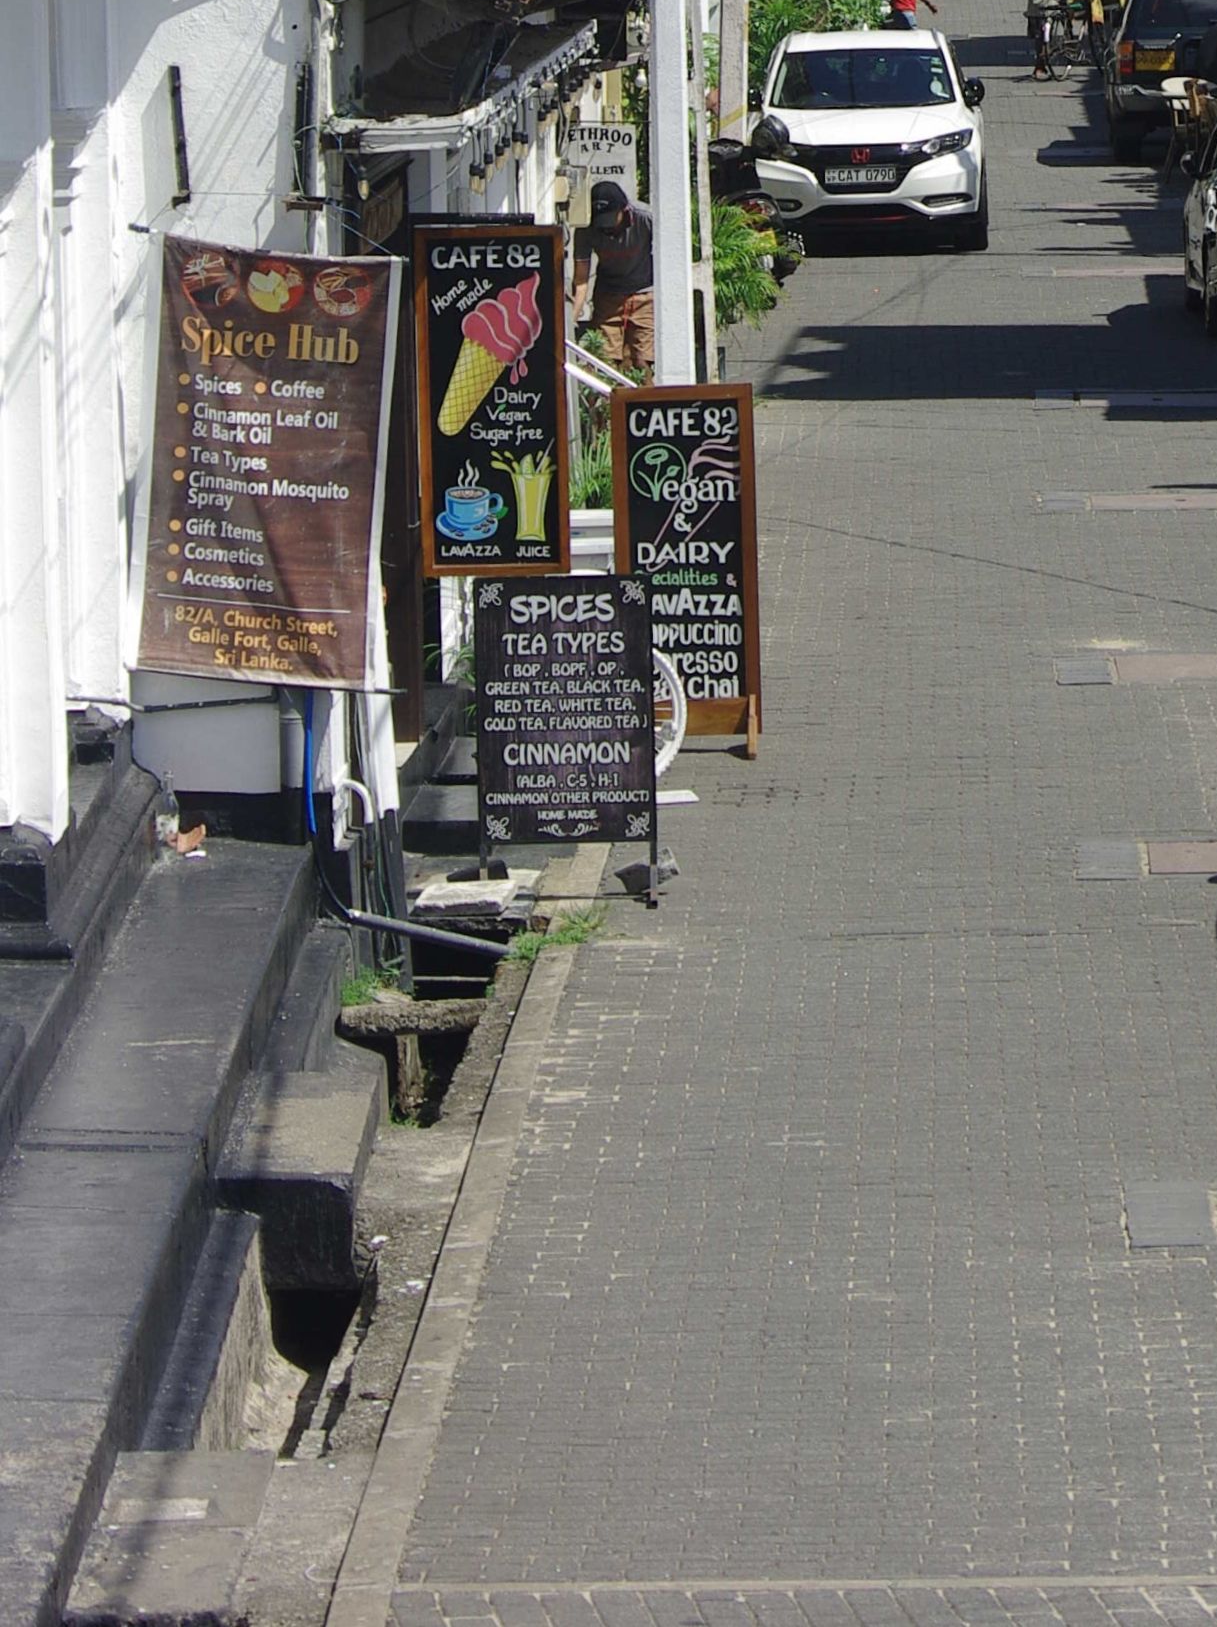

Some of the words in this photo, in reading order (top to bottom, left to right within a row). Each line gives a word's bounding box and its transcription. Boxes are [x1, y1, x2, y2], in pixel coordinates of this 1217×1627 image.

[581, 141, 615, 153] ART
[590, 165, 626, 175] LLERY
[838, 169, 861, 182] CAT
[866, 168, 896, 181] 0790
[431, 239, 504, 269] CAFÉ
[506, 243, 541, 269] 82
[430, 279, 468, 316] Home
[456, 277, 494, 313] made
[181, 316, 277, 366] Spice
[286, 323, 360, 364] Hub
[195, 373, 242, 396] Spices
[271, 379, 325, 399] Coffee
[494, 386, 542, 410] Dairy
[193, 402, 271, 426] Cinnamon
[276, 409, 311, 428] Leaf
[315, 411, 338, 430] Oil
[486, 404, 532, 425] Vegan
[628, 401, 701, 438] CAFÉ
[703, 407, 739, 436] 82
[192, 420, 207, 438] &
[212, 423, 245, 444] Bark
[250, 426, 272, 445] Oil
[470, 422, 513, 447] Sugar
[515, 424, 544, 446] free
[190, 446, 219, 465] Tea
[223, 450, 268, 474] Types
[189, 470, 268, 496] Cinnamon
[272, 479, 349, 503] Mosquito
[648, 476, 737, 514] Vegan
[188, 488, 234, 511] Spray
[185, 517, 217, 537] Gift
[220, 521, 264, 543] Items
[673, 512, 692, 532] &
[184, 541, 264, 566] Cosmetics
[441, 542, 501, 557] LAVAZZA
[516, 545, 551, 558] JUICE
[637, 541, 735, 565] DAIRY
[182, 568, 274, 593] Accessories
[642, 568, 718, 586] ecialities
[726, 573, 738, 587] &
[510, 593, 615, 623] SPICES
[652, 587, 742, 616] AVAZZA
[175, 604, 217, 627] 82/A,
[223, 610, 281, 631] Church
[286, 616, 338, 638] Street,
[652, 619, 742, 648] ppuccino
[189, 626, 230, 646] Galle
[234, 632, 272, 651] Fort,
[277, 634, 322, 656] Galle,
[502, 633, 547, 655] TEA
[552, 631, 625, 654] TYPES
[214, 648, 236, 666] Sri
[240, 651, 294, 670] Lanka.
[658, 650, 738, 674] resso
[485, 682, 530, 695] GREEN
[567, 680, 611, 693] BLACK
[687, 674, 739, 698] Chai
[494, 700, 521, 713] RED
[559, 698, 602, 712] WHITE
[484, 717, 516, 731] GOLD
[550, 716, 612, 729] FLAVORED
[503, 741, 630, 766] CINNAMON
[485, 793, 549, 805] CINNAMON
[551, 792, 590, 804] OTHER
[537, 810, 565, 820] HOME
[567, 809, 598, 820] MADE
